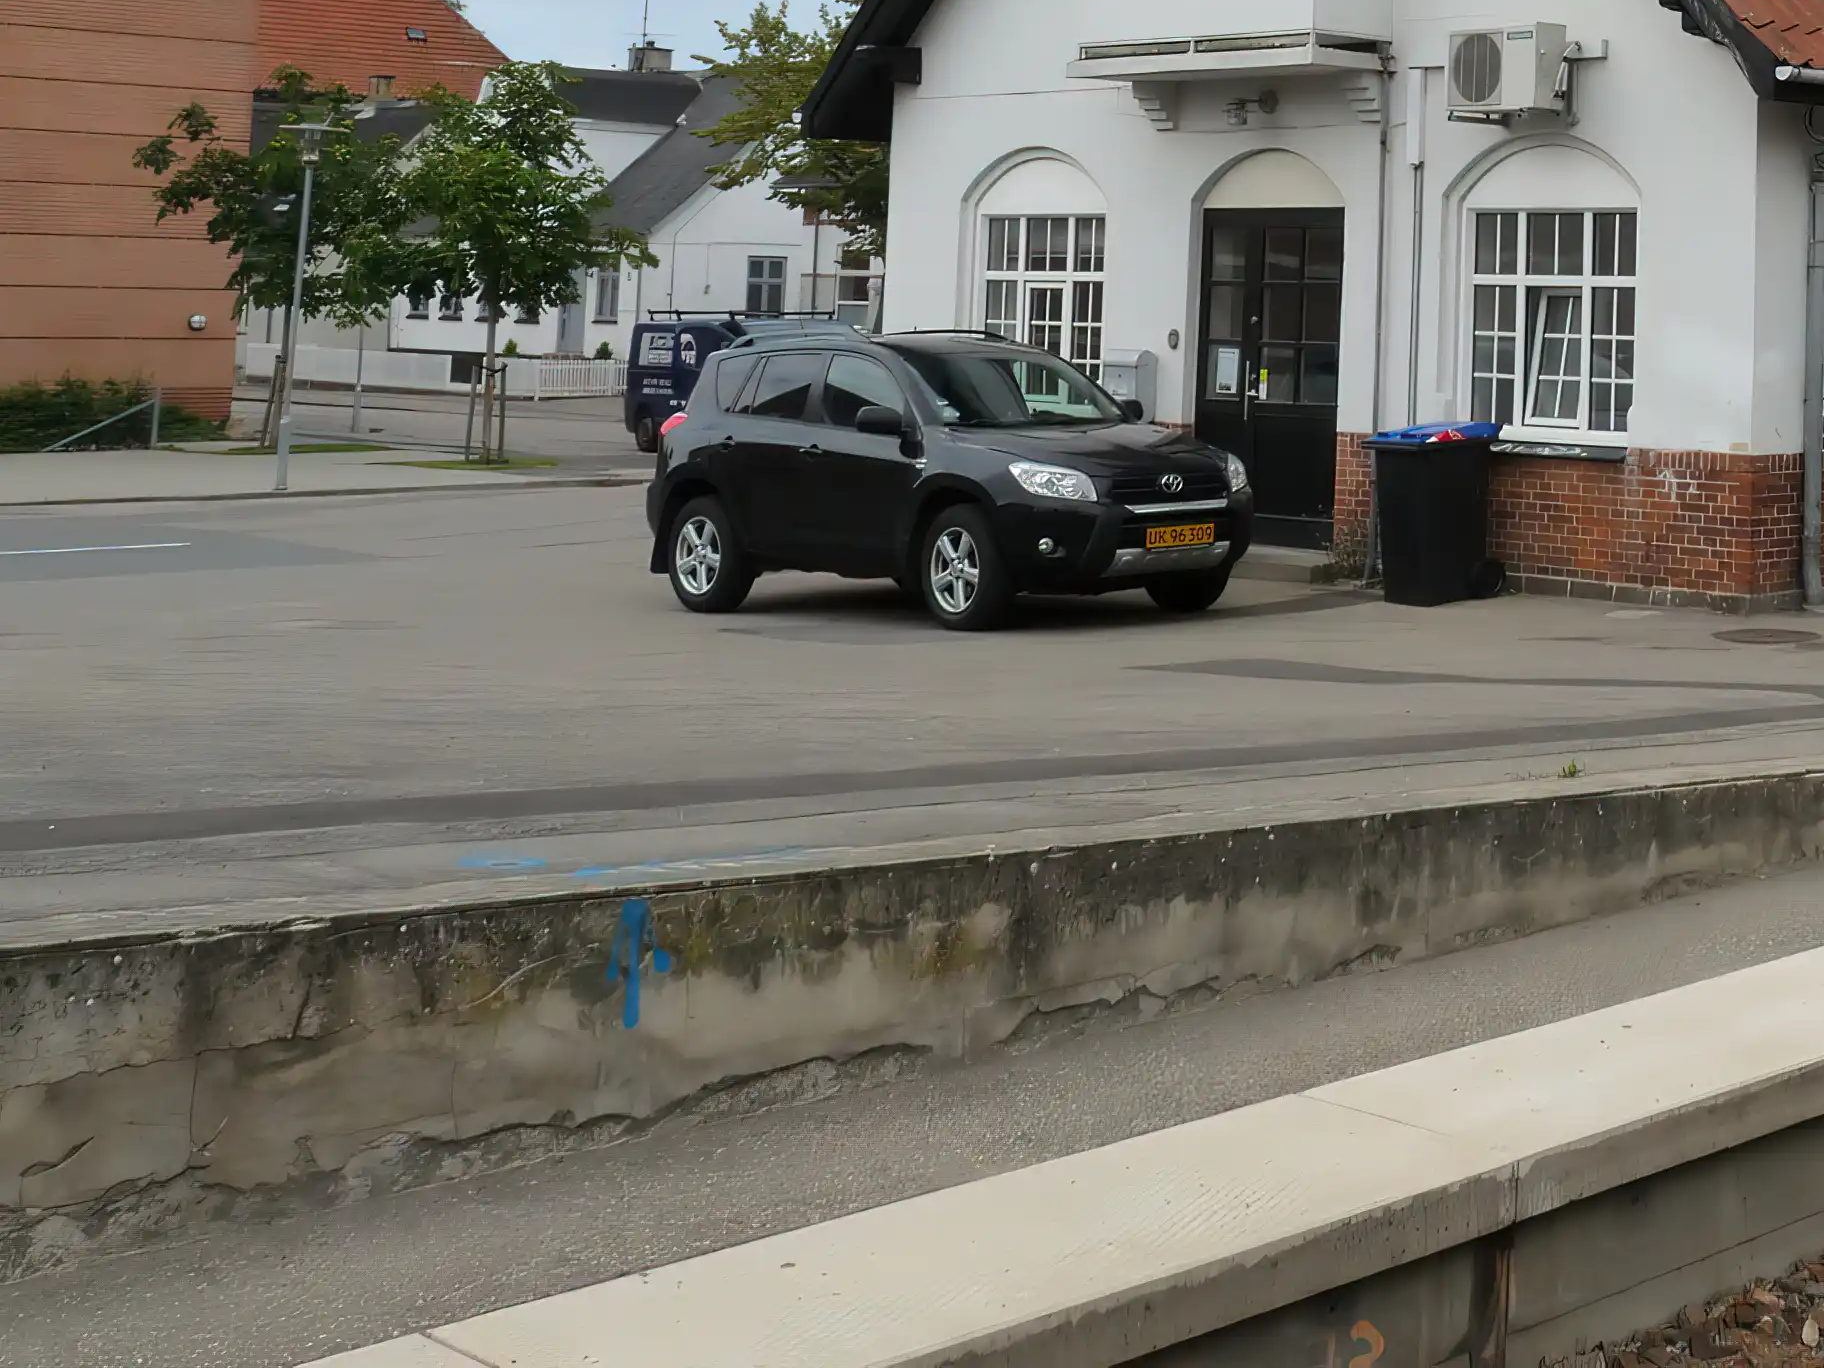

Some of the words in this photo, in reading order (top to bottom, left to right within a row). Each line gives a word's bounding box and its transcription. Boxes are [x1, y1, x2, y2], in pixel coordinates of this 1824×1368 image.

[1148, 530, 1167, 545] UK
[1170, 529, 1187, 543] 96
[1188, 526, 1213, 542] 309
